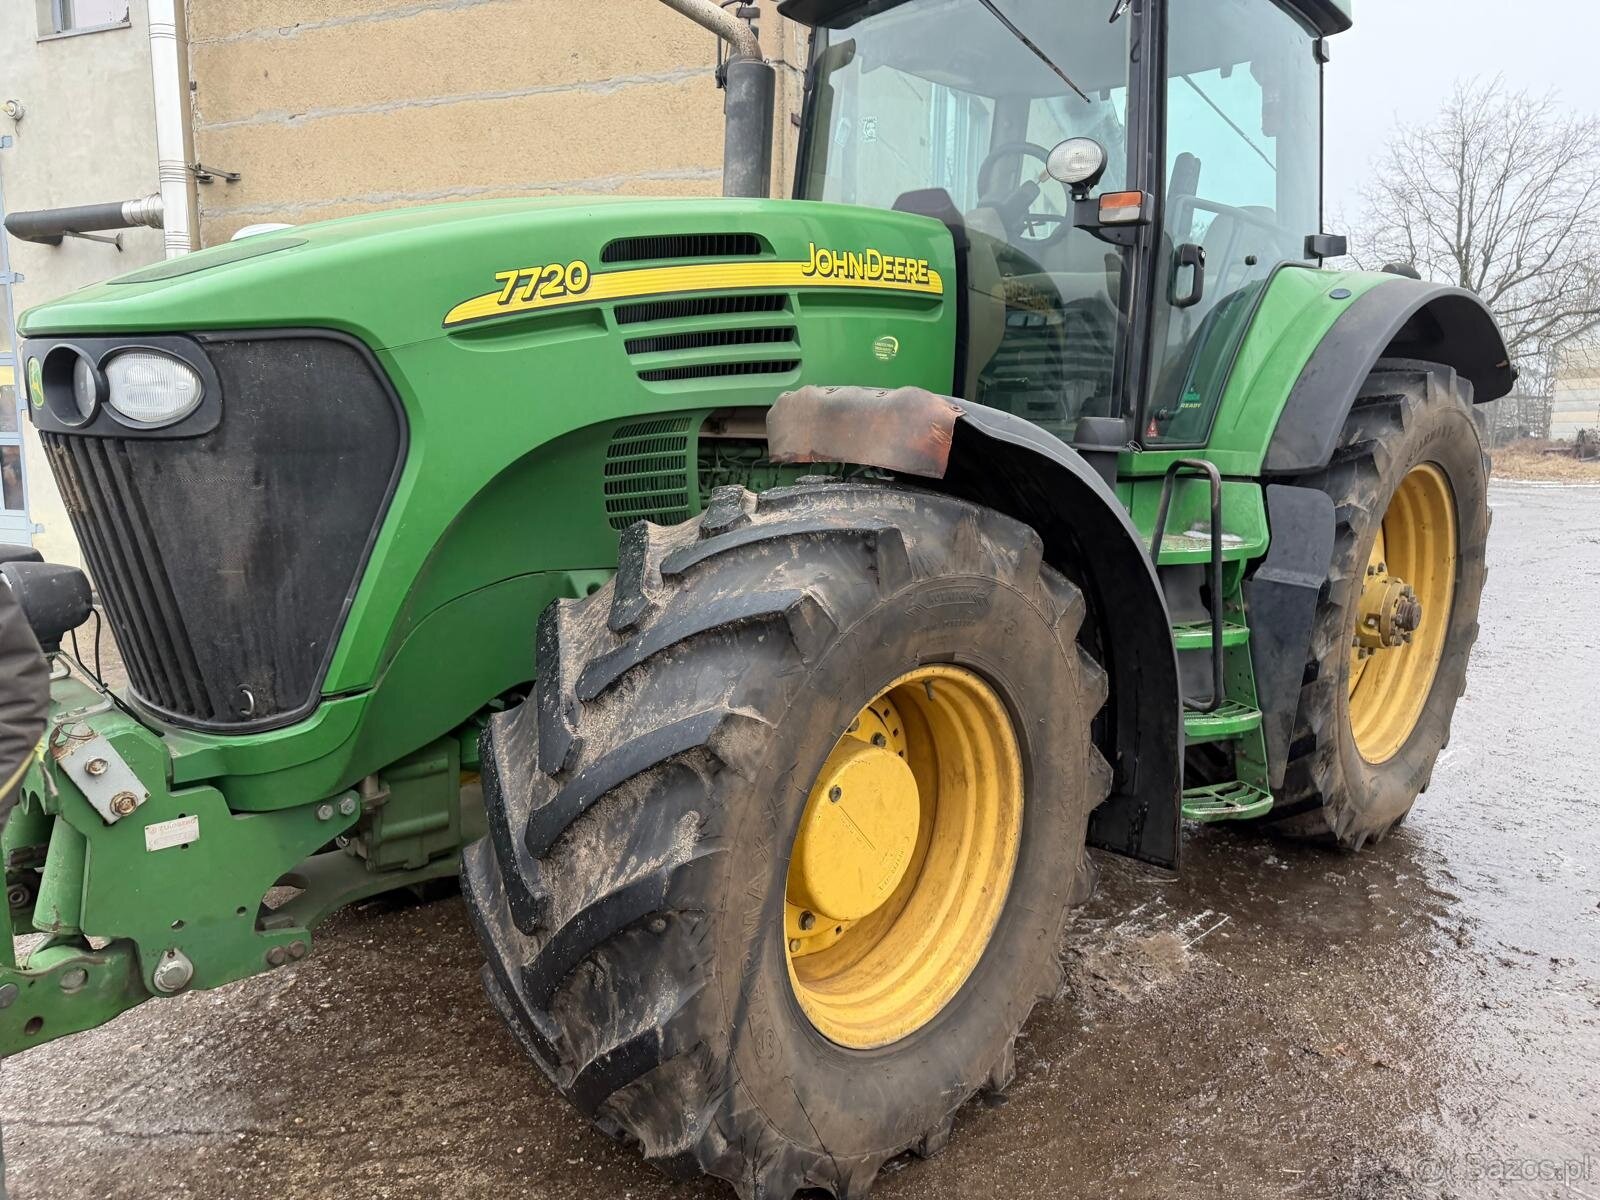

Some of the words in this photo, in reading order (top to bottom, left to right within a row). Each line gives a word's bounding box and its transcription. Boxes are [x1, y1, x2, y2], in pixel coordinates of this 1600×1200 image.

[495, 259, 591, 305] 7720
[801, 241, 864, 279] JOHN
[865, 248, 929, 284] DEERE
